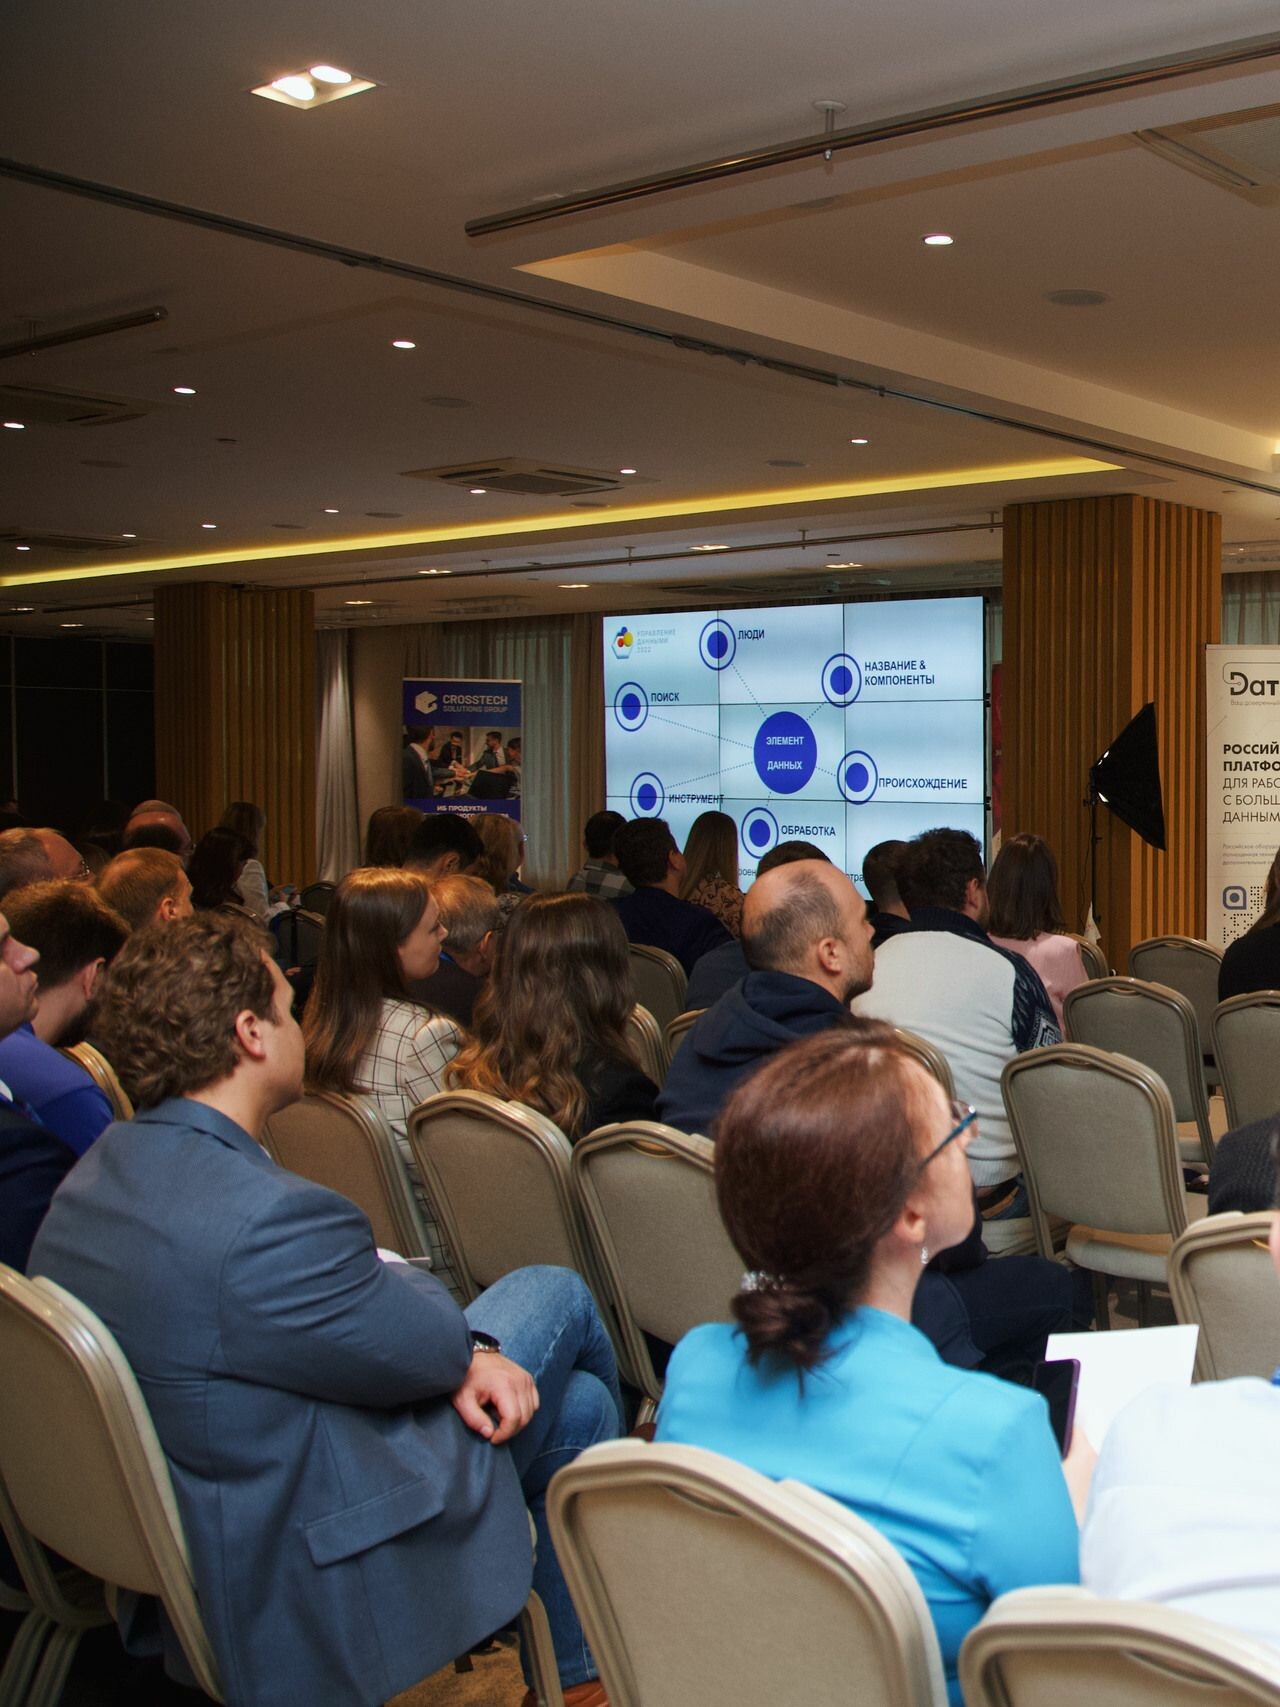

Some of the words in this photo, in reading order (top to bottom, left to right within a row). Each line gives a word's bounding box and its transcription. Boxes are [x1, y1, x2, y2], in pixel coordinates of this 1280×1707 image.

[738, 630, 765, 640] ЛЮДИ
[865, 661, 917, 671] НАЗВАНИЕ
[919, 660, 926, 670] &
[865, 675, 935, 685] КОМПОНЕНТЫ
[443, 694, 508, 705] CROSSTECH
[651, 693, 679, 702] ПОИСК
[766, 736, 804, 745] ЭЛЕМЕНТ
[767, 760, 803, 770] ДАННЫХ
[879, 778, 967, 789] ПРОИСХОЖДЕНИЕ
[1222, 778, 1248, 790] ДЛЯ
[1223, 795, 1232, 805] С
[781, 825, 836, 836] ОБРАБОТКА
